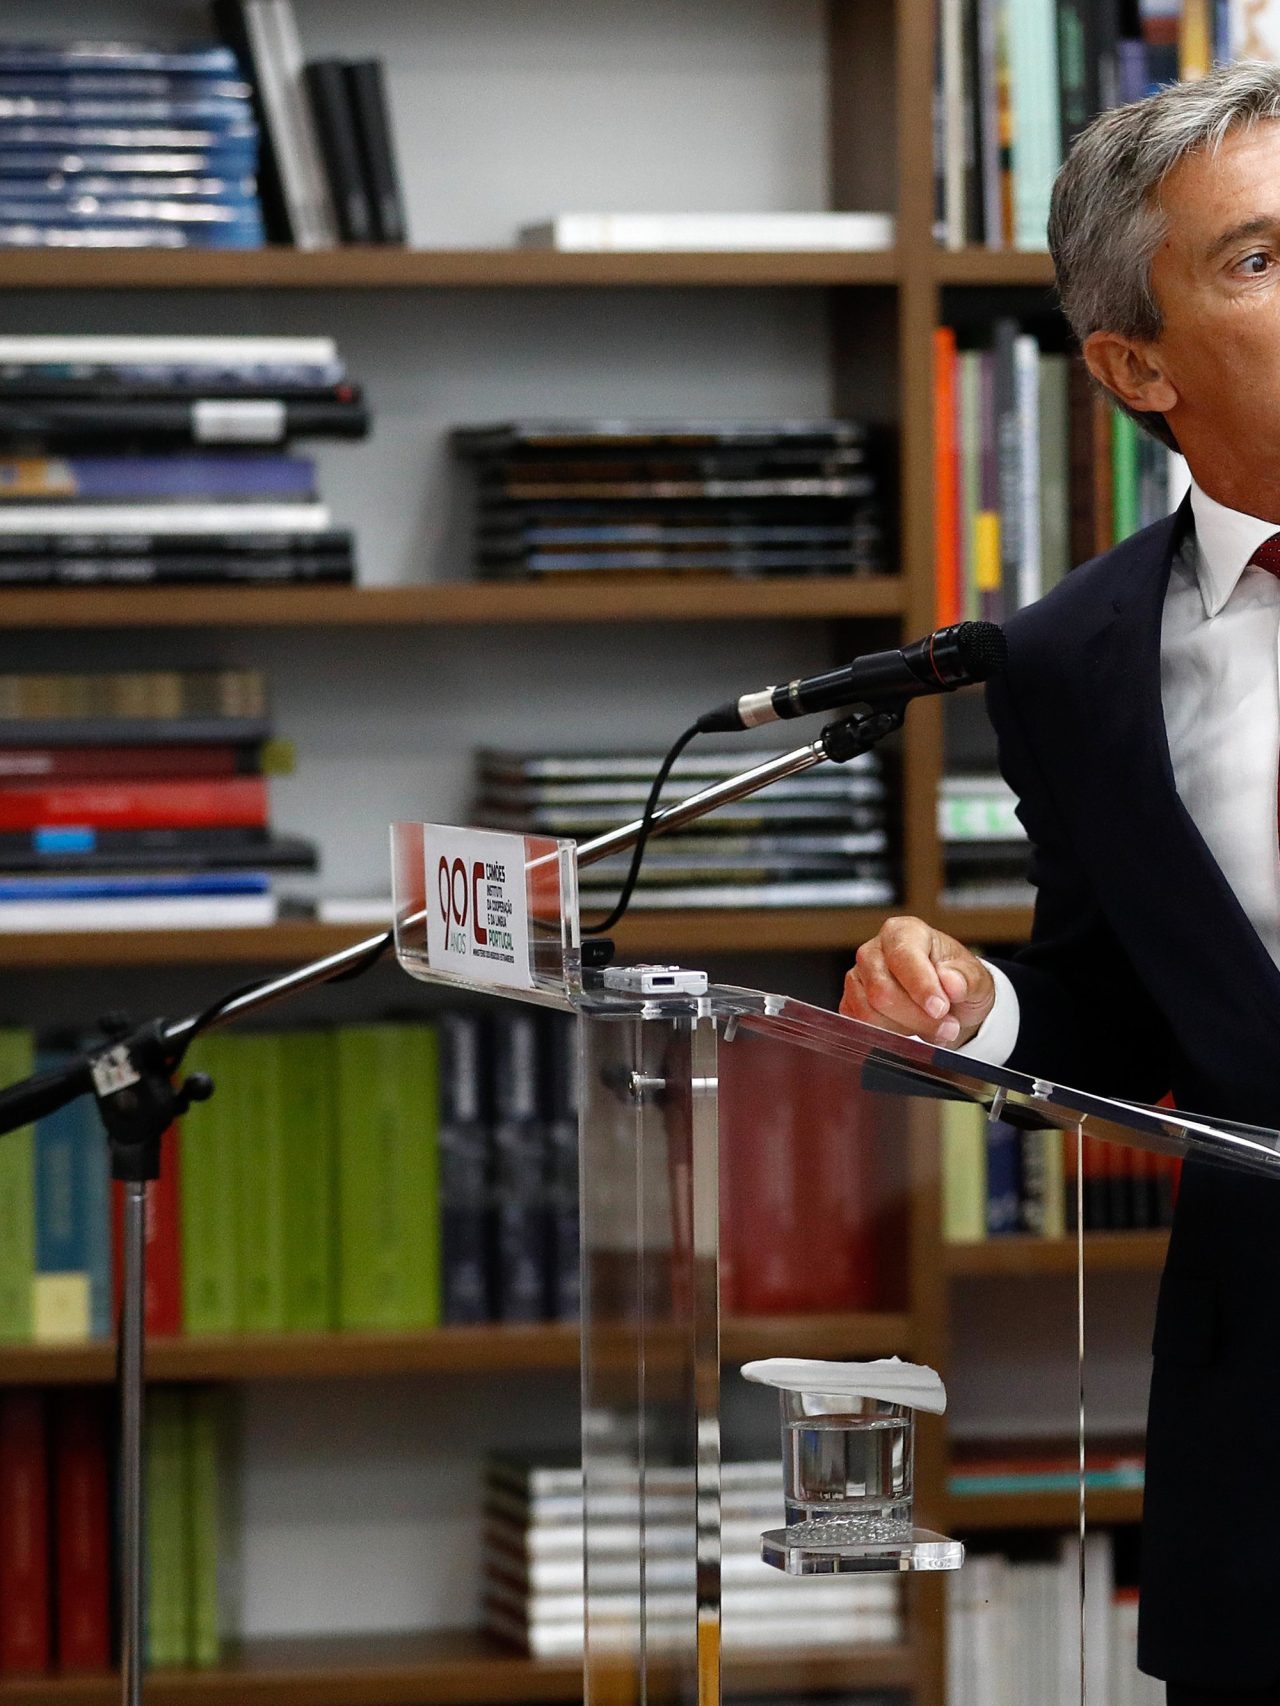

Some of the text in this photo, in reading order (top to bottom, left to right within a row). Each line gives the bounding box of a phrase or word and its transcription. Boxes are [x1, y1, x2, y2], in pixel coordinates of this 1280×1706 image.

[486, 861, 505, 883] CAMÕES
[450, 931, 466, 954] ANOS
[489, 929, 514, 951] PORTUGAL
